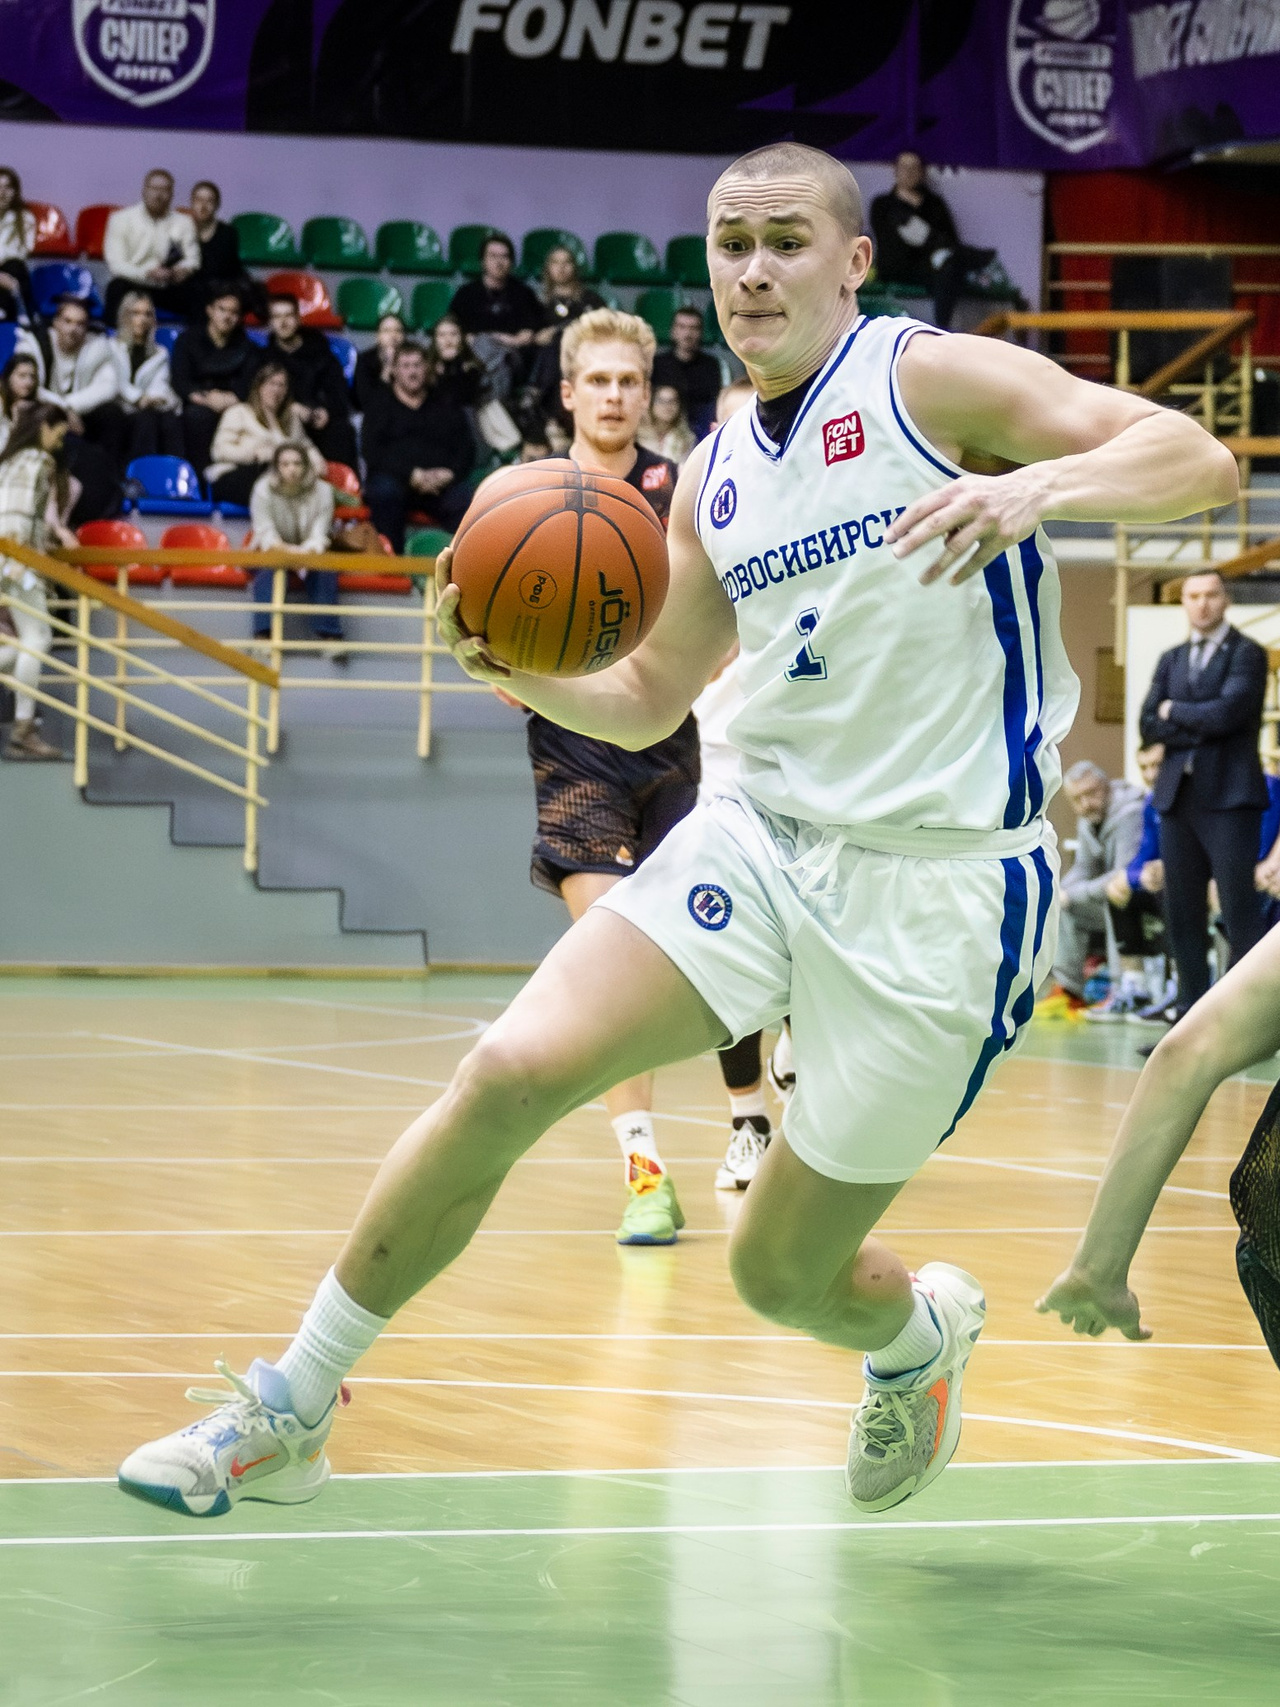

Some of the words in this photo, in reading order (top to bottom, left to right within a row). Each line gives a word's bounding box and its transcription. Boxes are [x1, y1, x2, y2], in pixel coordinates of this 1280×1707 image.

[100, 17, 189, 63] СУПЕР
[451, 0, 791, 70] FONBET
[826, 415, 857, 444] FON
[828, 432, 862, 462] BET
[721, 506, 907, 603] ОВОСИБИРС
[783, 606, 828, 683] 1
